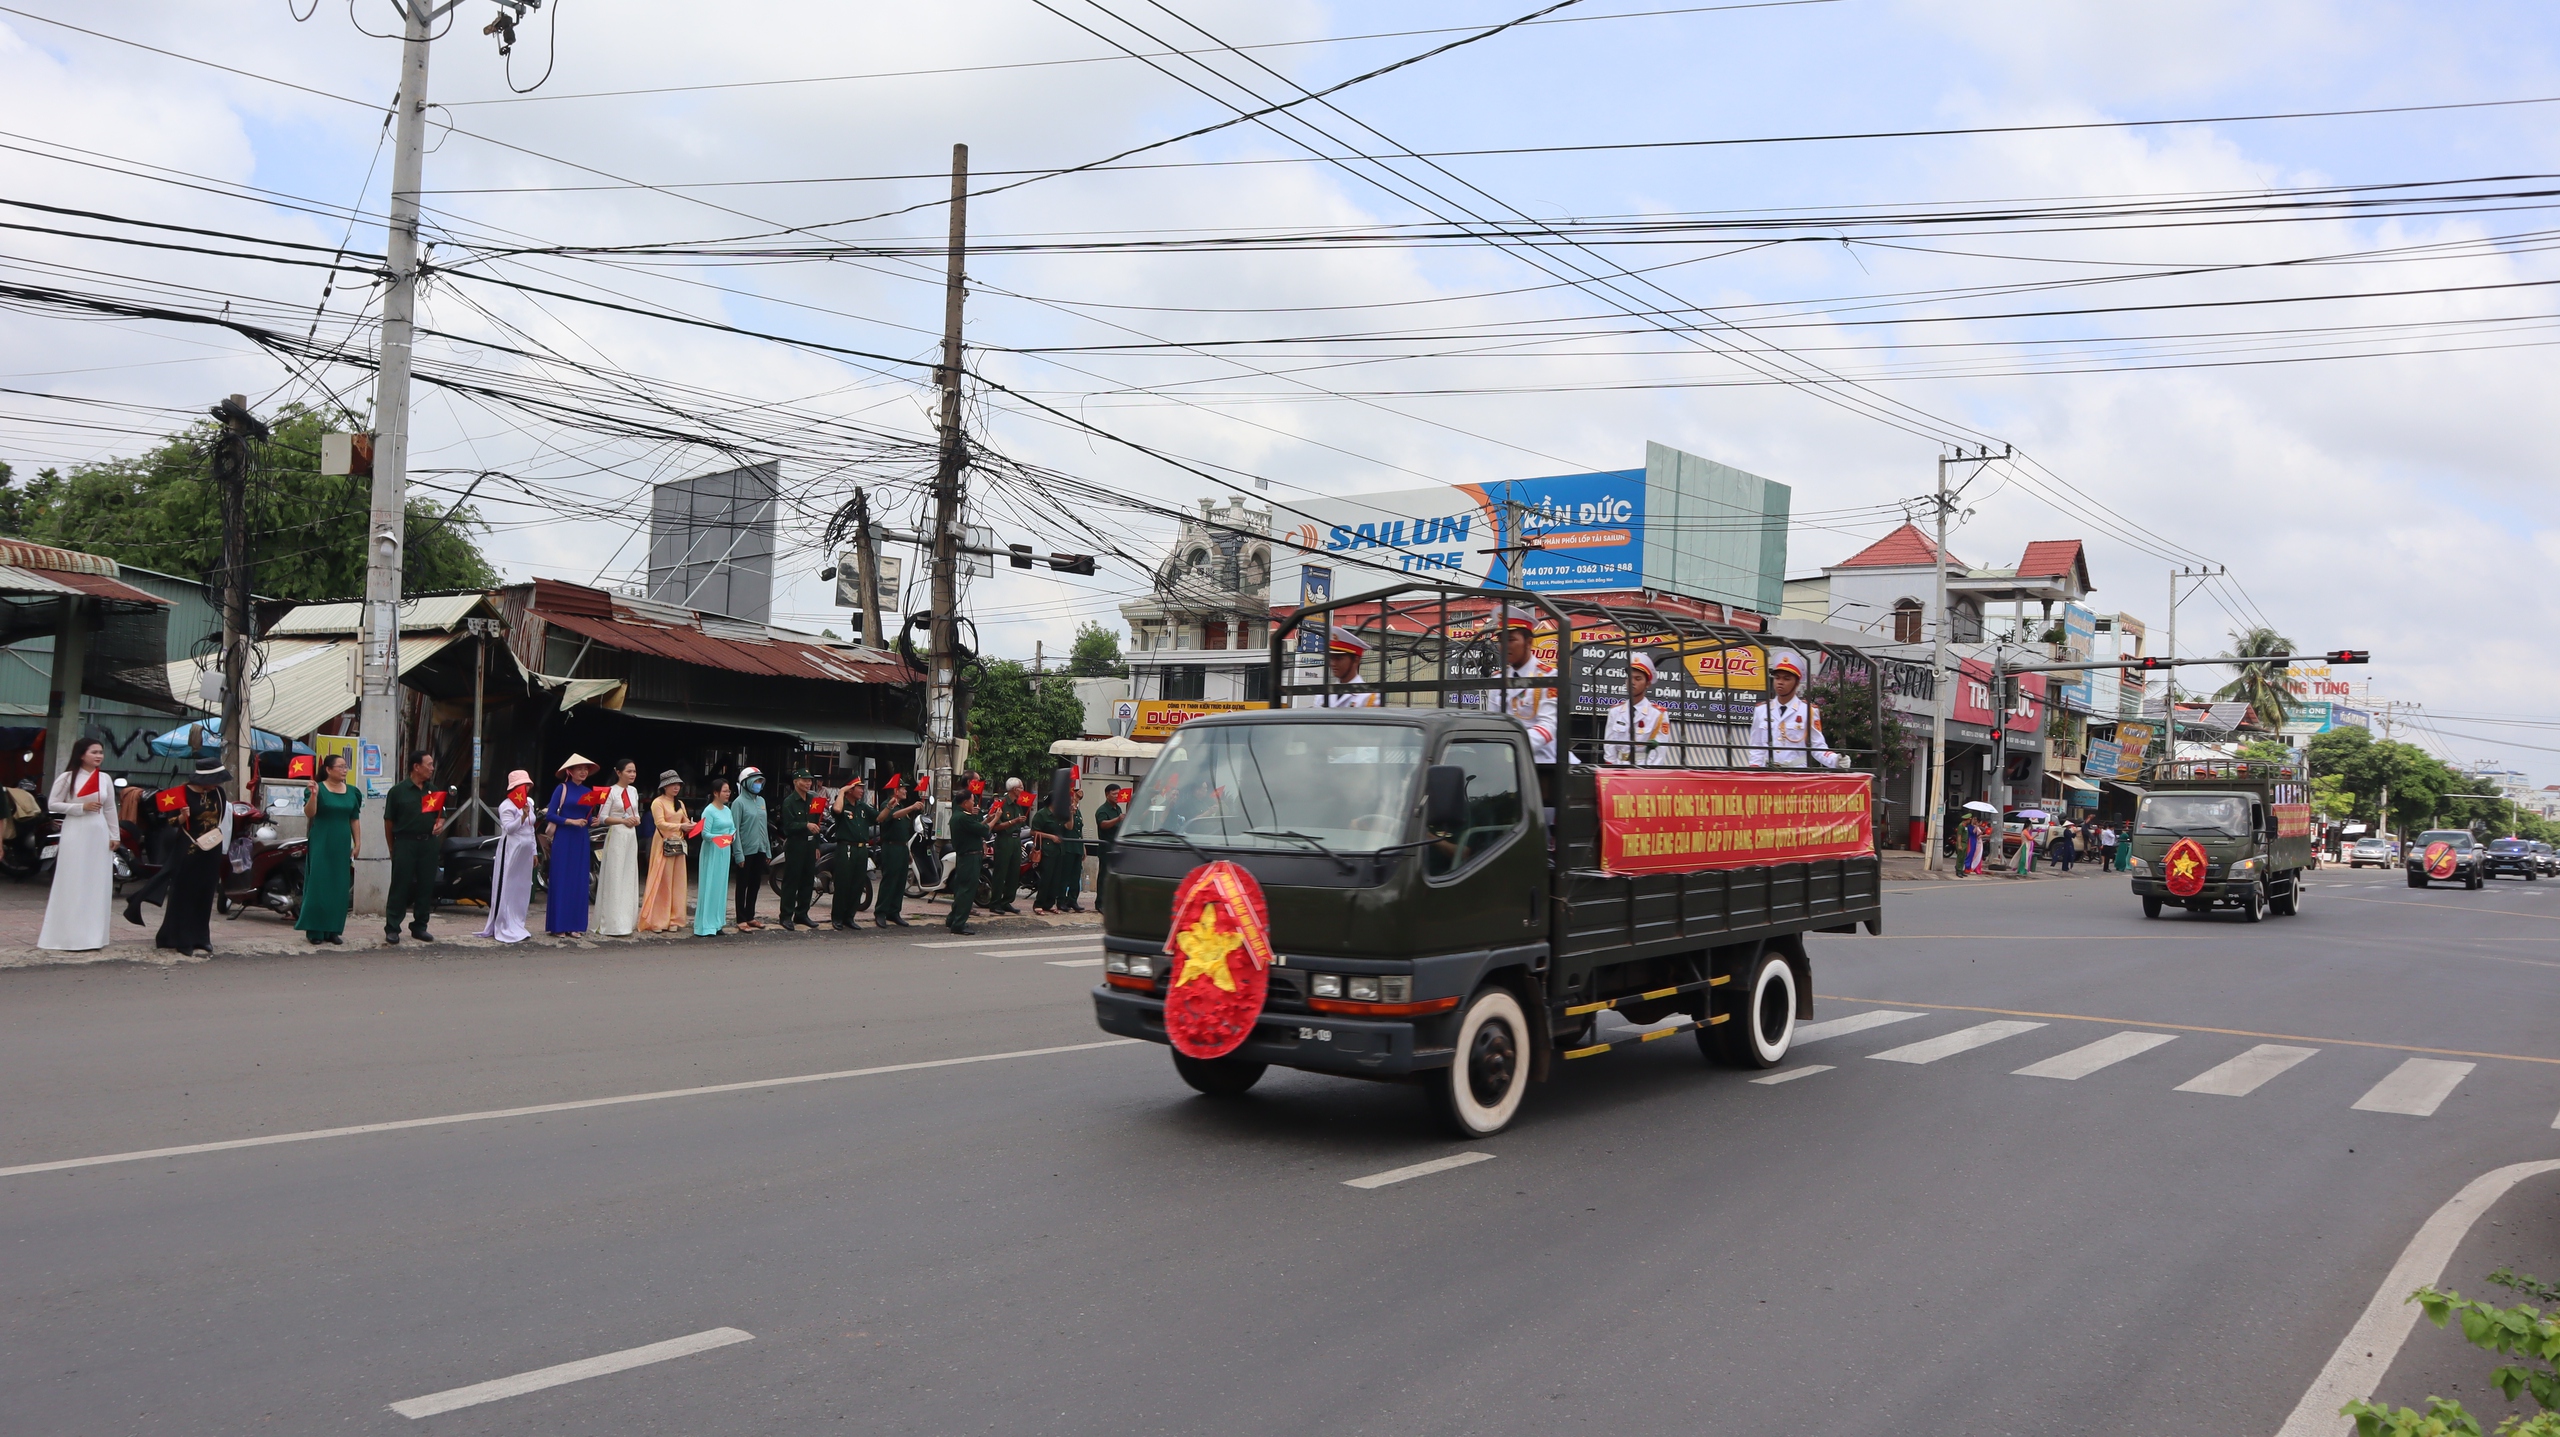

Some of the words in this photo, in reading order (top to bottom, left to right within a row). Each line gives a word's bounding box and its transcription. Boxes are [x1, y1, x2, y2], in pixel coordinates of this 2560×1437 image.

[1519, 494, 1571, 529] RẦN
[1579, 494, 1633, 526] ĐỨC
[1327, 514, 1472, 551] SAILUN
[1561, 533, 1577, 544] PHỐI
[1578, 532, 1591, 543] LỐP
[1592, 533, 1602, 543] TẢI
[1603, 533, 1626, 542] SAILUN
[1399, 551, 1465, 573] TIRE
[1520, 567, 1537, 577] 944
[1538, 566, 1554, 576] 070
[1555, 566, 1570, 575] 707
[1576, 564, 1597, 574] 0362
[1600, 563, 1615, 573] 198
[1582, 646, 1606, 659] BẢO
[1605, 666, 1631, 678] CHỮ
[2304, 664, 2331, 677] THẤT
[1685, 688, 1707, 699] TÚT
[1708, 703, 1756, 714] SUZUK
[2308, 707, 2326, 715] ONE
[1612, 790, 1636, 823] THỰC
[1636, 788, 1657, 822] HIỆN
[1657, 785, 1672, 817] TỐT
[1674, 788, 1695, 817] CÔNG
[1695, 788, 1710, 817] TÁC
[1710, 789, 1724, 816] TÌM
[1745, 794, 1758, 819] QUY
[1760, 789, 1773, 819] TẬP
[1785, 786, 1798, 815] CỐT
[1799, 789, 1812, 816] LIỆT
[1622, 827, 1651, 858] THIÊNG
[1651, 826, 1674, 856] LIÊNG
[1674, 822, 1691, 854] CỦA
[1707, 821, 1722, 852] CẤP
